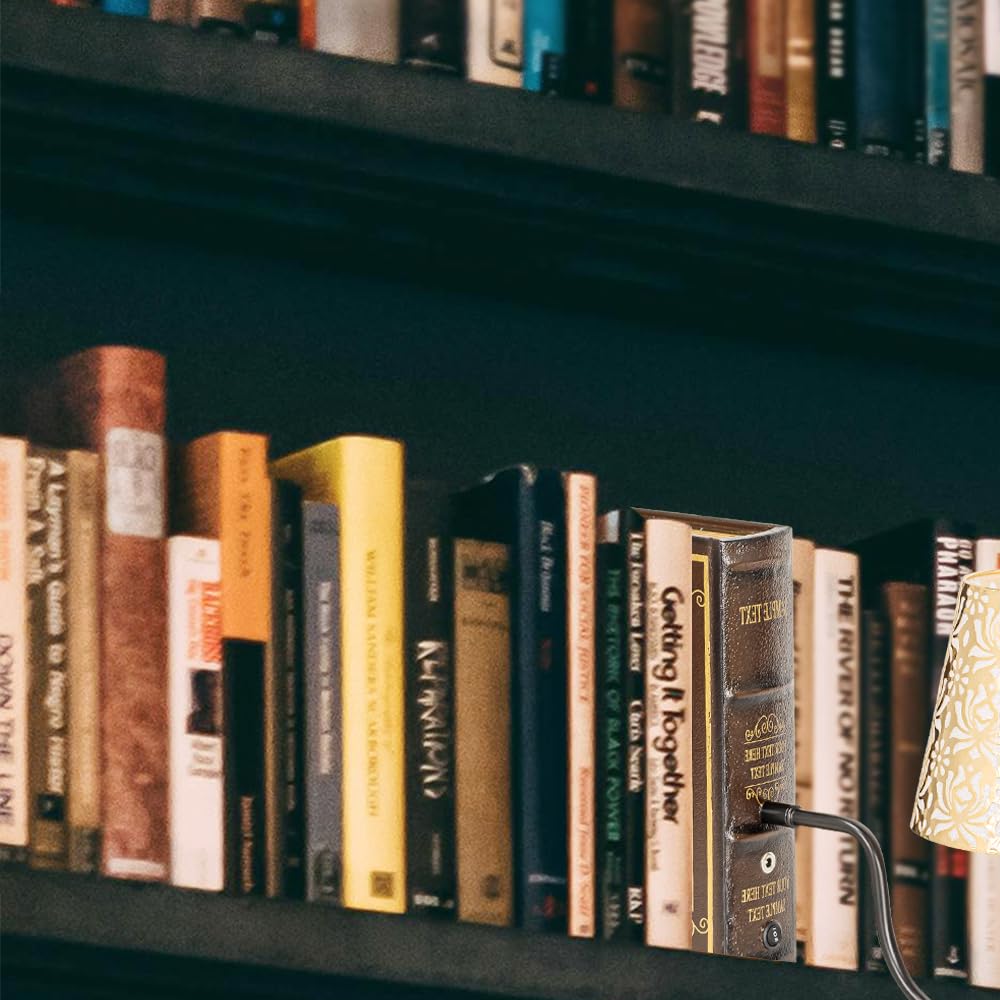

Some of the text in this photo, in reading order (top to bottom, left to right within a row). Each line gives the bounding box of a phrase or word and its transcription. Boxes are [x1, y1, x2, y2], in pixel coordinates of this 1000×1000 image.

[629, 532, 645, 560] The
[365, 550, 380, 618] WILLIAM
[936, 537, 959, 636] PHARAOH
[47, 643, 65, 664] to
[629, 631, 645, 673] Lover
[45, 671, 65, 728] Negro
[629, 701, 645, 742] Chris
[653, 586, 686, 826] Getting It Together
[837, 575, 857, 907] THE RIVER OF NO RTURN
[606, 776, 620, 841] POWER
